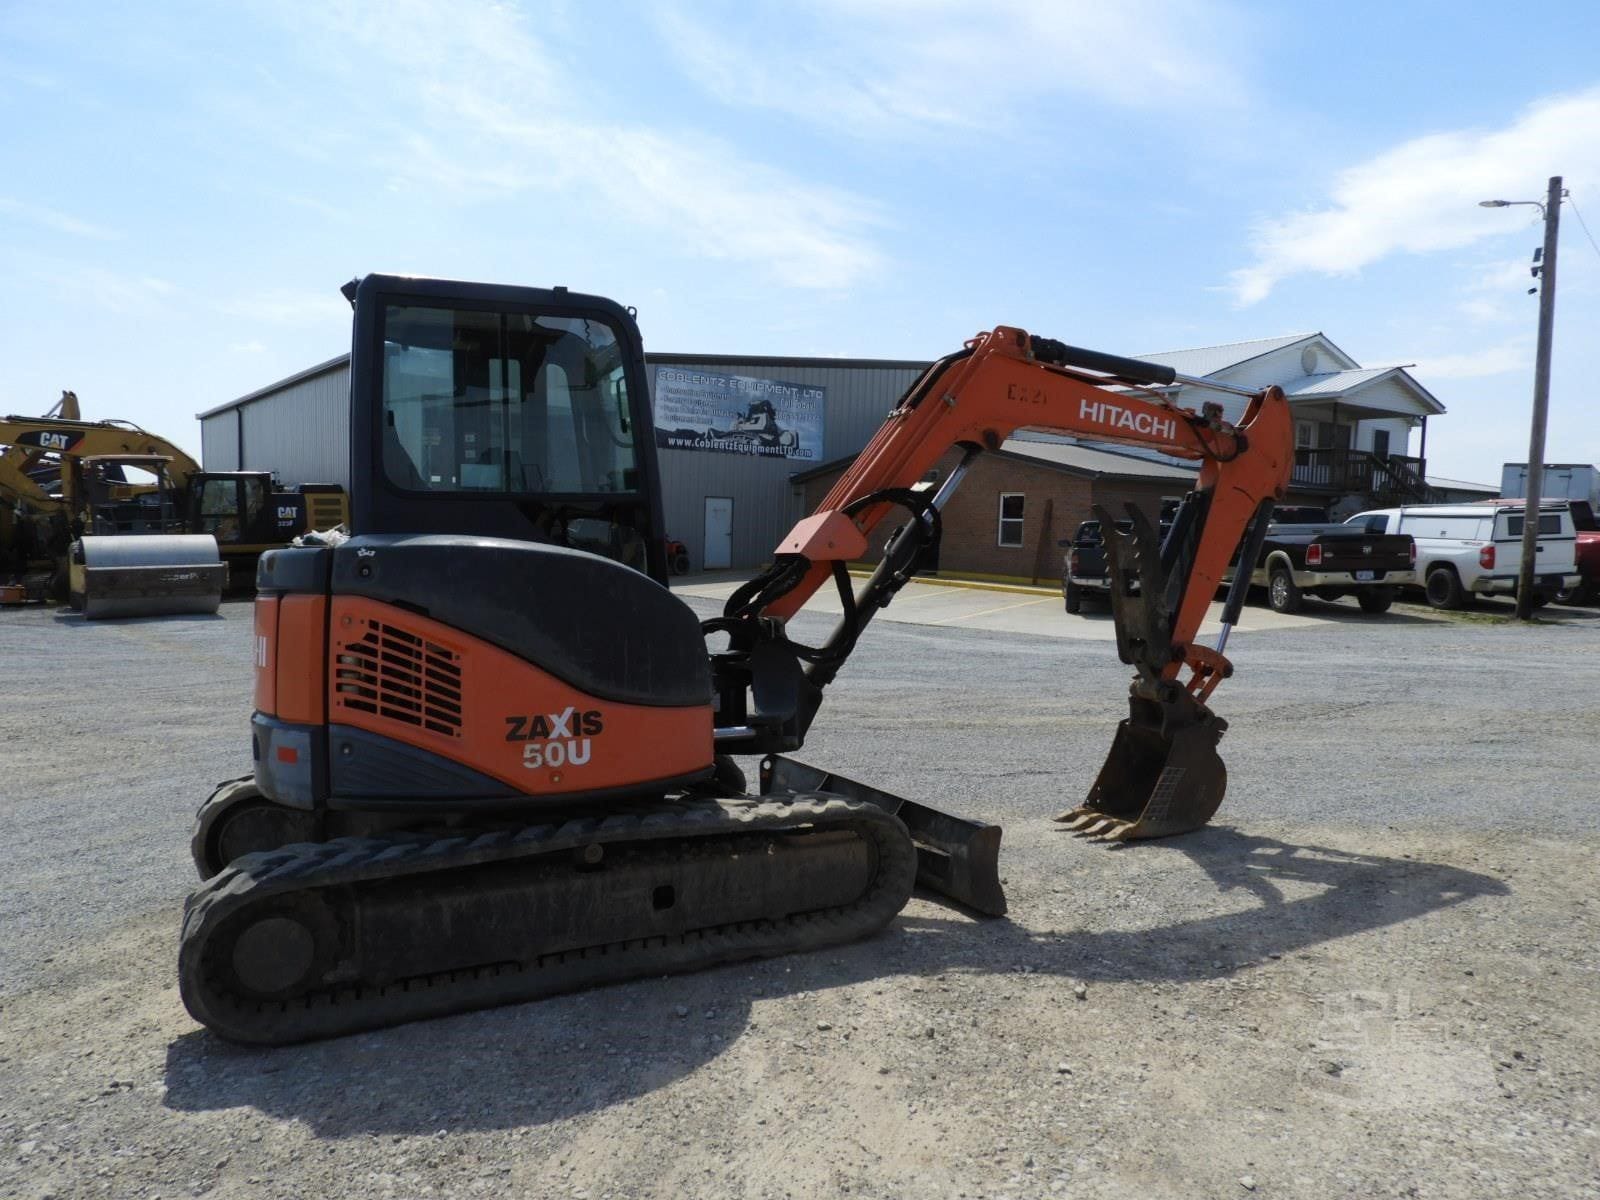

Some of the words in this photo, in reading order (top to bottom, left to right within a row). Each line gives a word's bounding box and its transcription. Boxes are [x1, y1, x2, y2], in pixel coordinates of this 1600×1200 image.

[659, 371, 725, 388] COBLENTZ
[1080, 399, 1176, 440] HITACHI
[40, 432, 69, 449] CAT
[668, 437, 813, 457] www.CoblentzEquipmentLTD.com
[278, 506, 297, 519] CAT
[505, 706, 603, 741] ZAXIS
[523, 738, 591, 769] 50U
